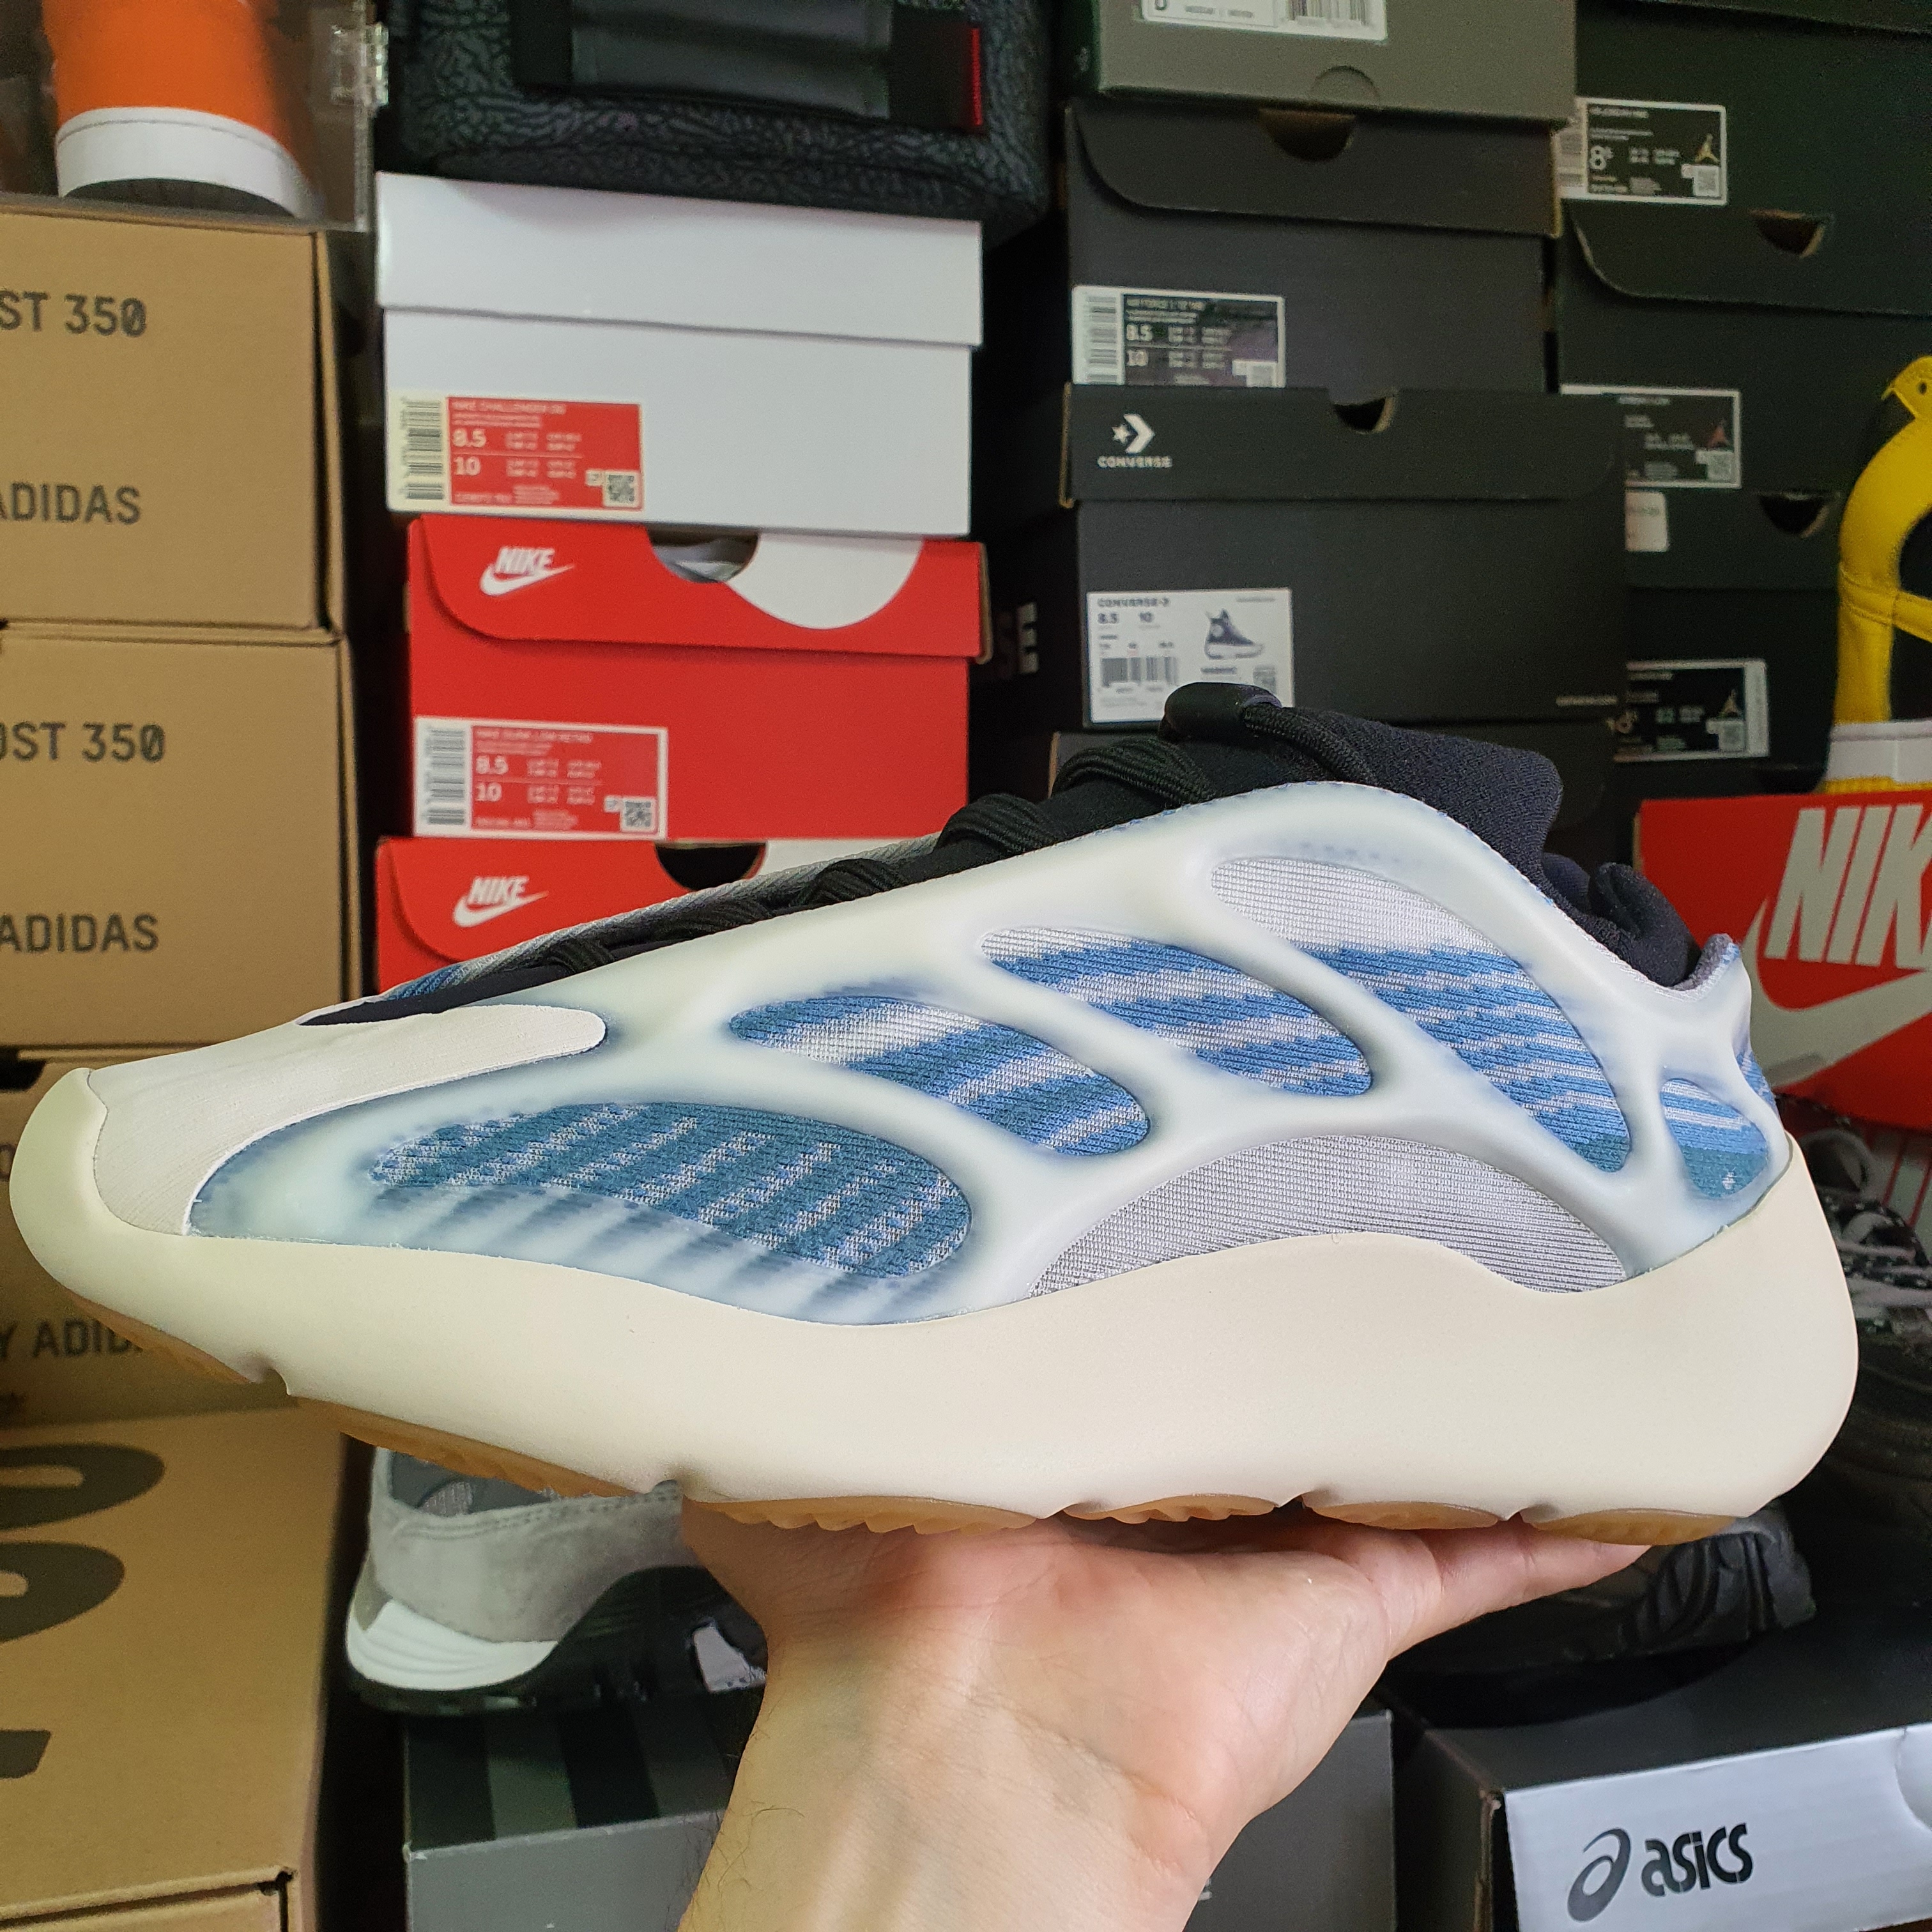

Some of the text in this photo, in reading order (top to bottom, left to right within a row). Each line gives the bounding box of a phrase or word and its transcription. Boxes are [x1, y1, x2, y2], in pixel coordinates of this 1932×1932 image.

[64, 293, 148, 339] 350
[452, 428, 487, 447] 8.5
[454, 456, 482, 476] 10
[1096, 455, 1173, 469] CONVERSE
[494, 546, 556, 575] NIKE
[0, 721, 166, 763] ST 350
[475, 755, 509, 775] 8.5
[475, 782, 503, 802] 10
[466, 875, 530, 906] NIKE
[1763, 803, 1932, 971] NIK
[0, 911, 160, 954] ADIDAS
[1640, 1821, 1754, 1898] asics
